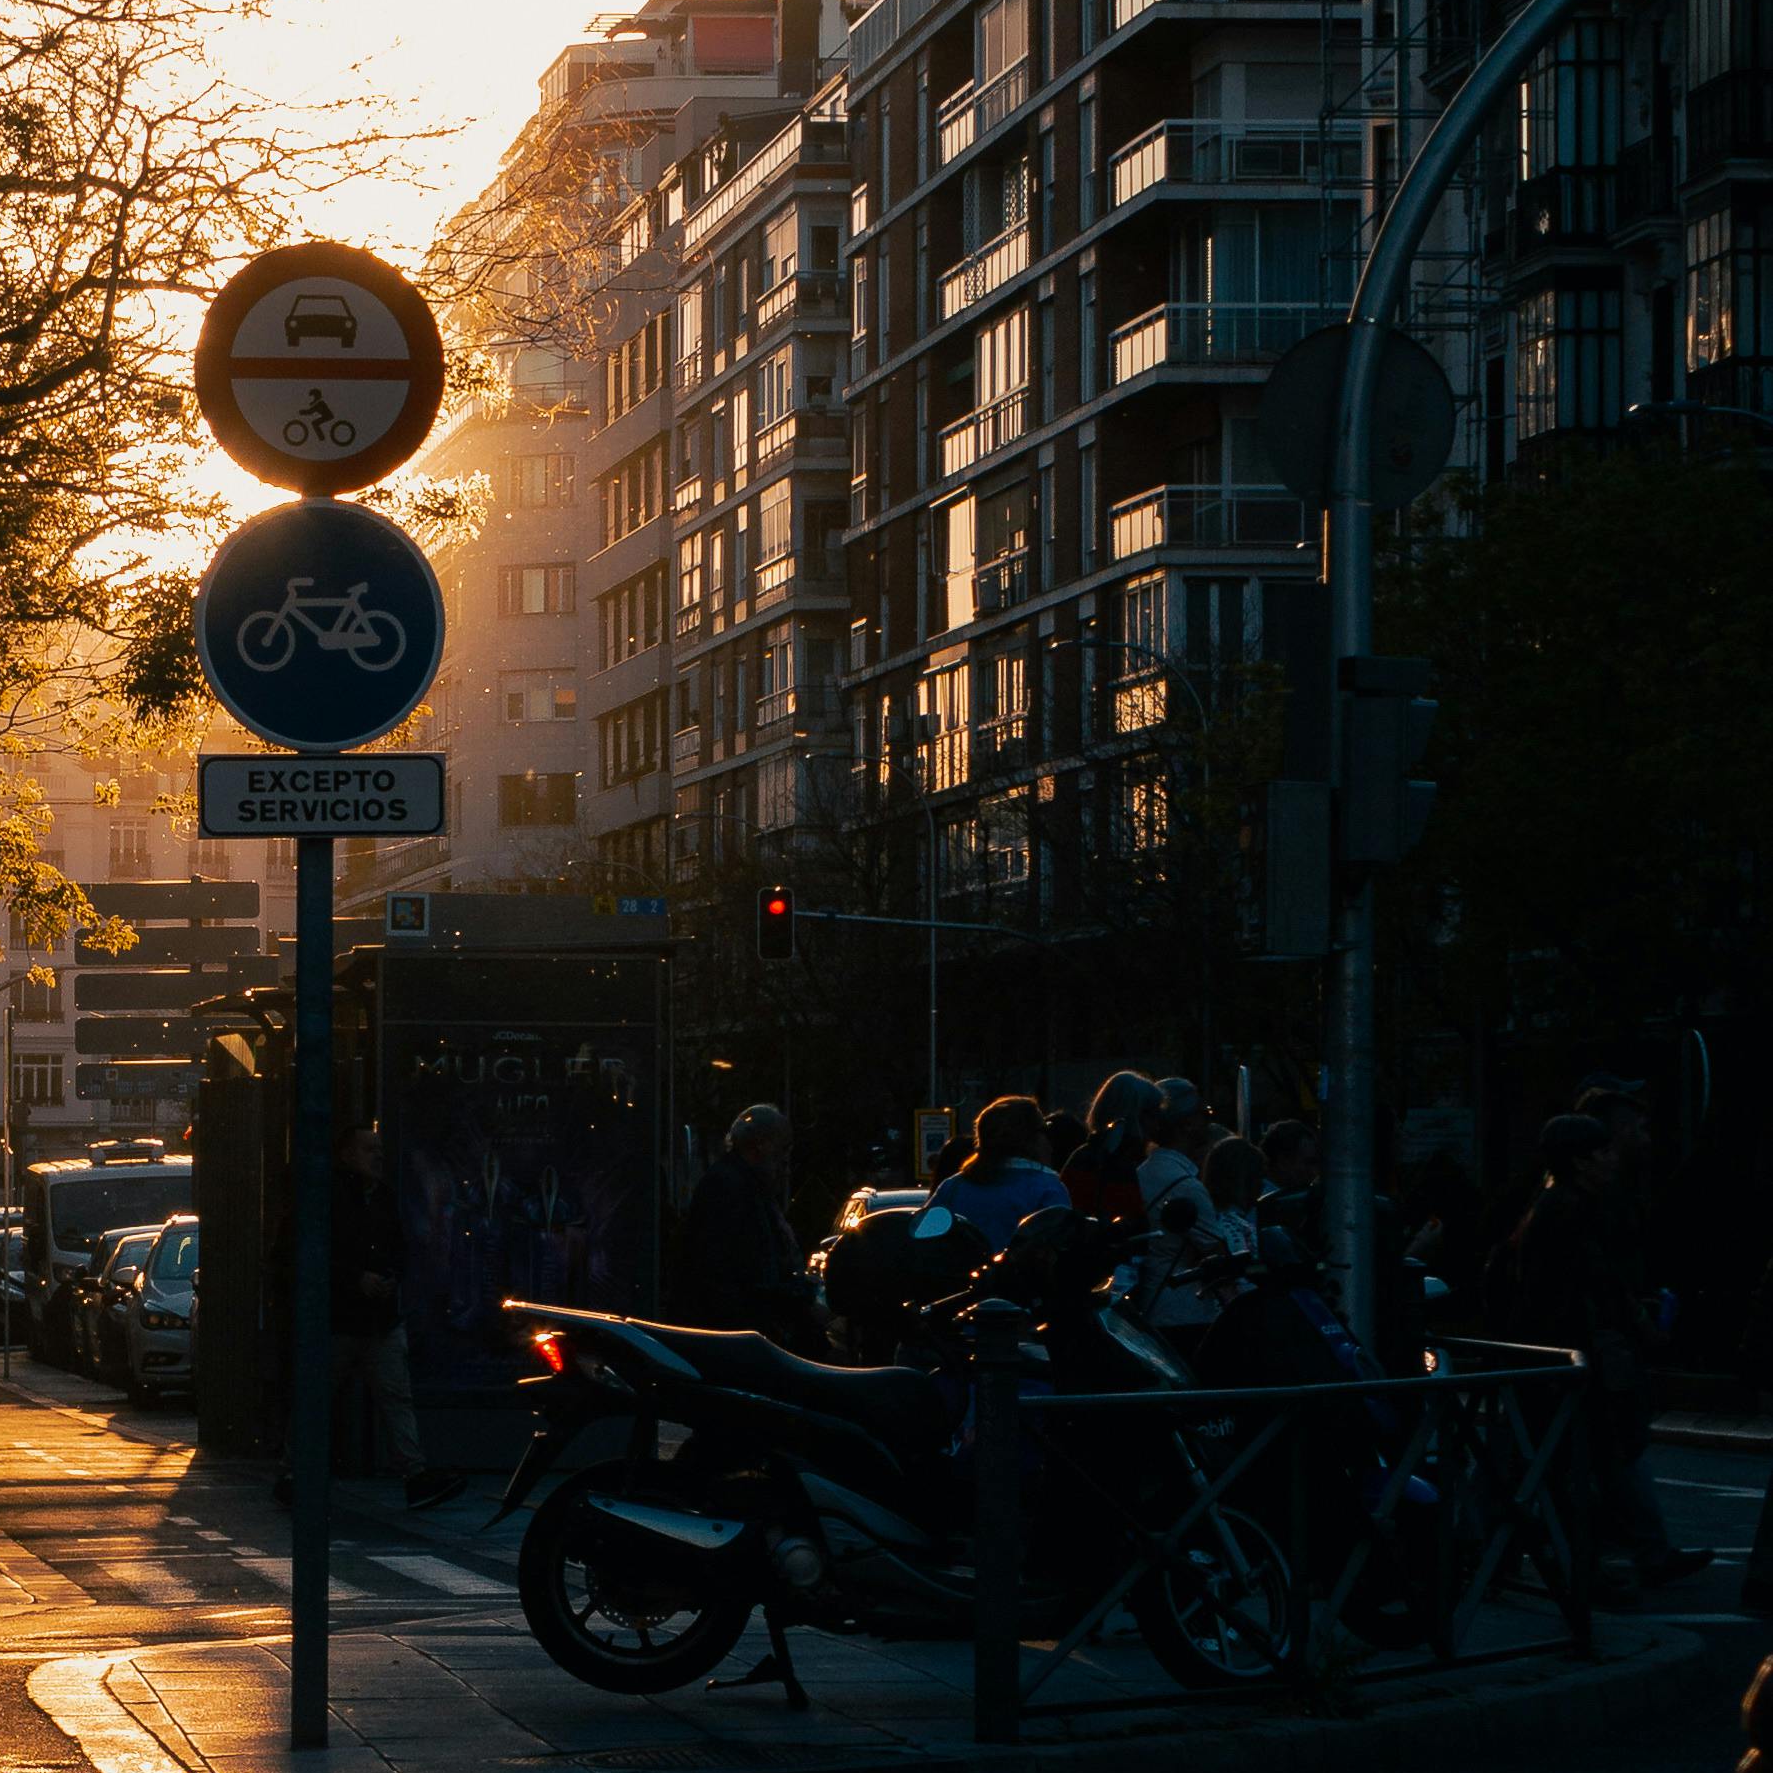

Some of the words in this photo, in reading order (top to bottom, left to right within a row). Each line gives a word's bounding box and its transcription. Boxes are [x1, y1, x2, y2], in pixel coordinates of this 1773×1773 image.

[247, 769, 396, 793] EXCEPTO
[237, 798, 408, 823] SERVICIOS
[621, 899, 638, 913] 28
[650, 899, 659, 914] 2
